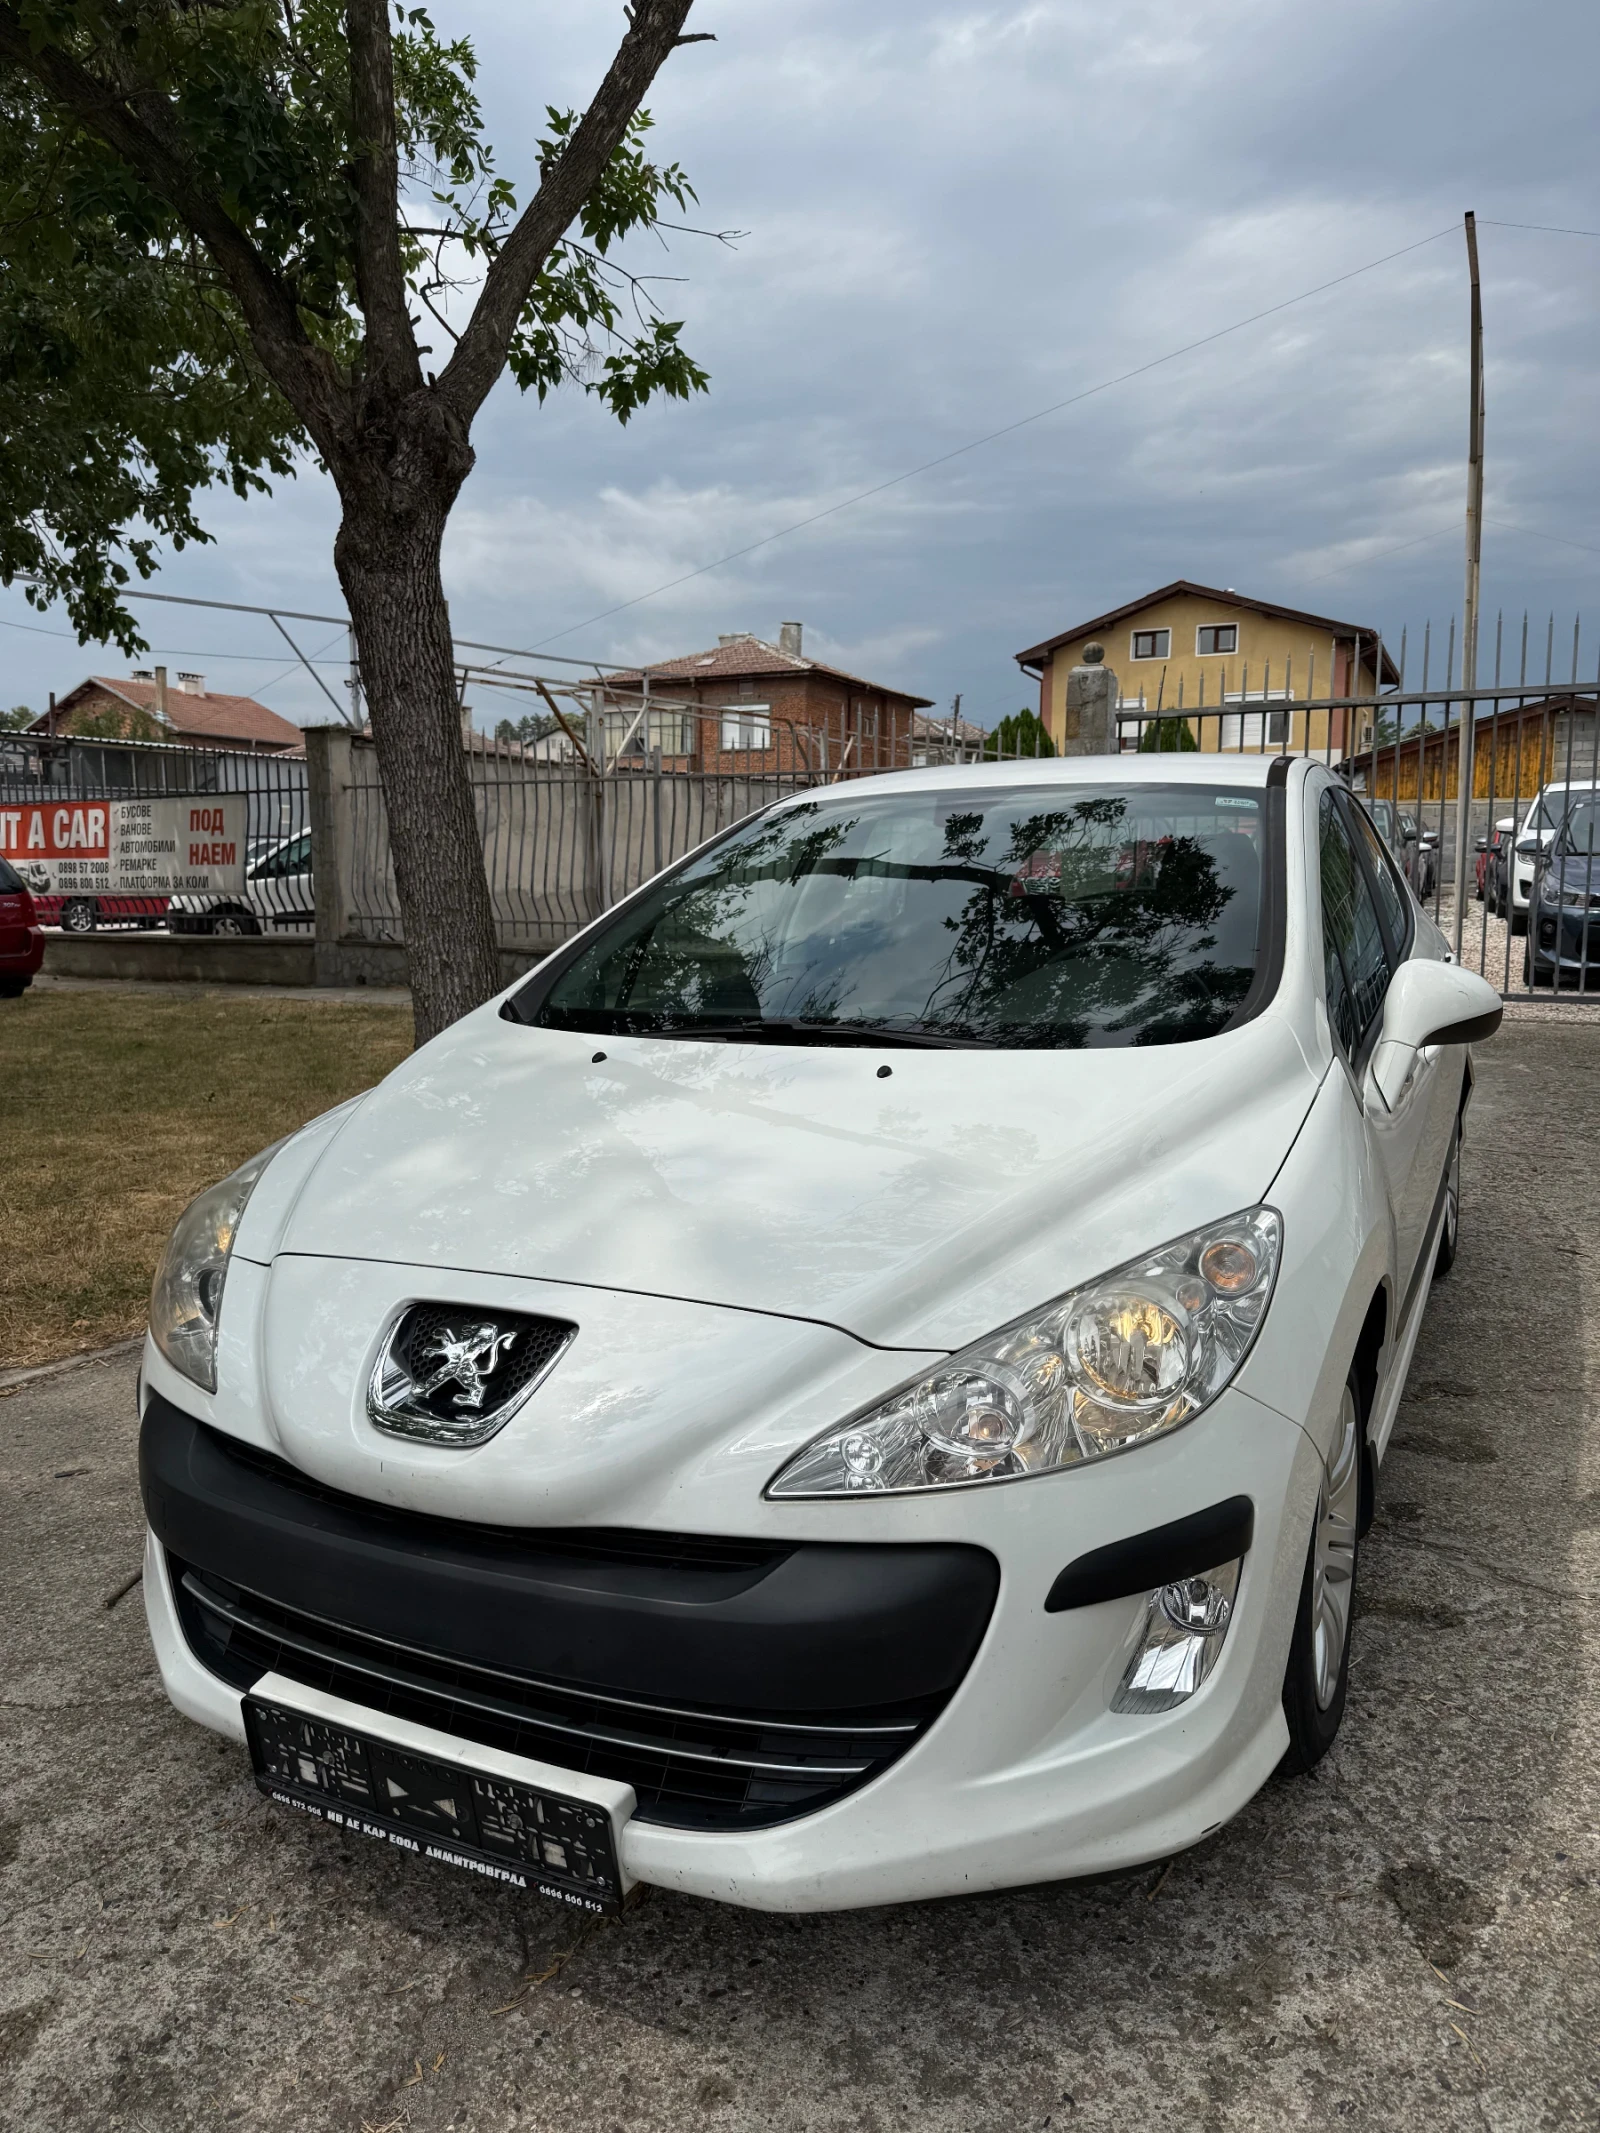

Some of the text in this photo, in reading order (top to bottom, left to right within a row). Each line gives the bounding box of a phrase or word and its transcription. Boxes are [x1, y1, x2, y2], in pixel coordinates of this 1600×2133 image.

[121, 805, 151, 818] БУСОВЕ
[190, 808, 224, 836] ПОД
[27, 811, 46, 849] A
[53, 809, 105, 849] CAR
[121, 823, 152, 836] ВАНОВЕ
[120, 840, 175, 853] АВТОМОБИЛИ
[189, 842, 236, 866] НАЕМ
[59, 862, 109, 874] 0898 57 2008
[120, 858, 157, 871] РЕМАРКЕ
[59, 877, 110, 889] 0896 800 512
[120, 875, 209, 889] ПЛАТФОРМА ЗА КОЛИ
[291, 1799, 307, 1810] 572
[327, 1810, 527, 1888] ИВ ДЕ КАР ЕООД ДИМИТРОВГРАД
[585, 1900, 603, 1913] 512
